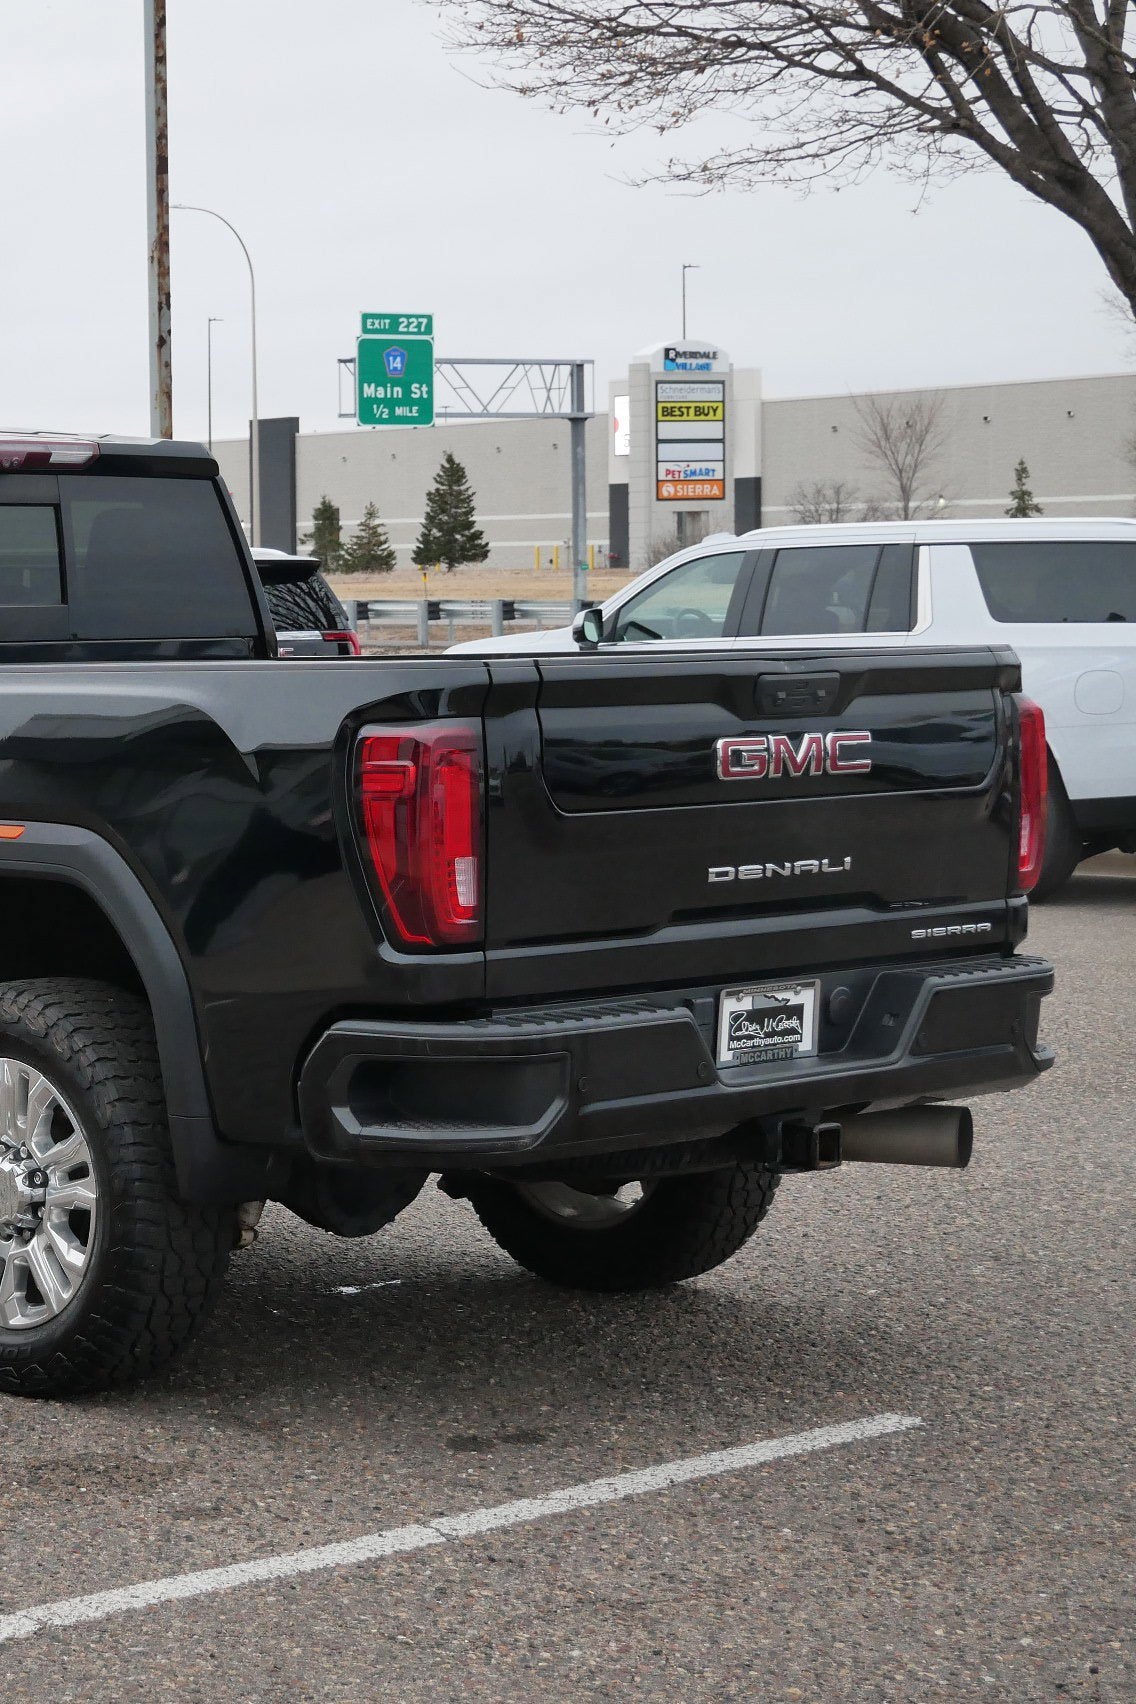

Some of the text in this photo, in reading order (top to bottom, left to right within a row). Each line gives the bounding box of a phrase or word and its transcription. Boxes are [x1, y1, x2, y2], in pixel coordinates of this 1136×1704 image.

[366, 317, 428, 332] EXIT 227
[388, 356, 402, 370] 14
[363, 383, 428, 398] Main St
[395, 406, 419, 417] MILE
[661, 405, 719, 418] BEST BUY
[676, 484, 720, 497] SIERRA
[717, 731, 871, 780] GMC
[708, 856, 852, 883] DENALI
[911, 922, 992, 939] SIERRA
[743, 984, 797, 995] MINNESOTA
[729, 1034, 801, 1049] McCarthyauto.com
[740, 1046, 792, 1064] MCCARTHY
